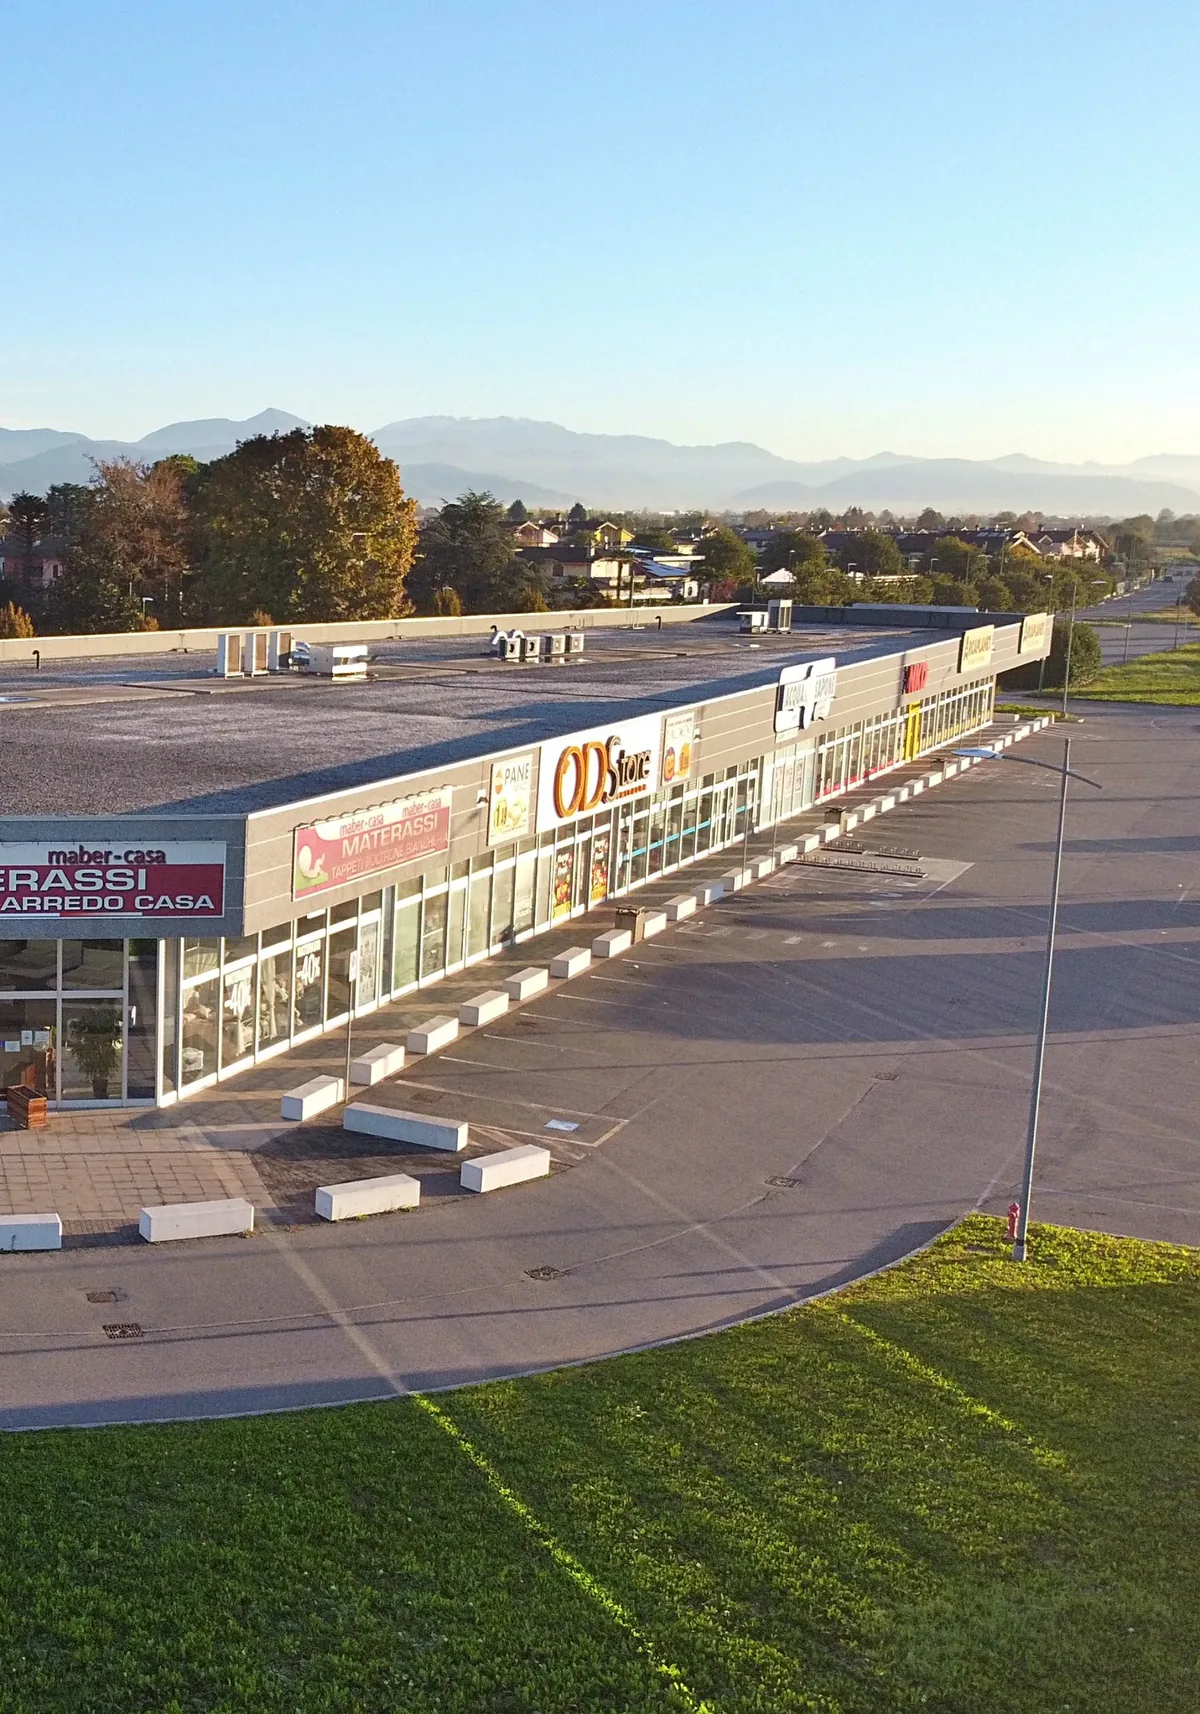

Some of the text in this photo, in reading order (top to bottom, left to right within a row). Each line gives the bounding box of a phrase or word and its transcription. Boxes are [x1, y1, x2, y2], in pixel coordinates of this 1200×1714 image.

[504, 762, 530, 785] PANE
[402, 797, 442, 818] maber-casa
[340, 813, 385, 837] maber-casa
[341, 812, 438, 859] MATERASSI
[48, 844, 167, 865] maber-casa
[0, 895, 124, 911] ARREDO
[134, 894, 215, 910] CASA
